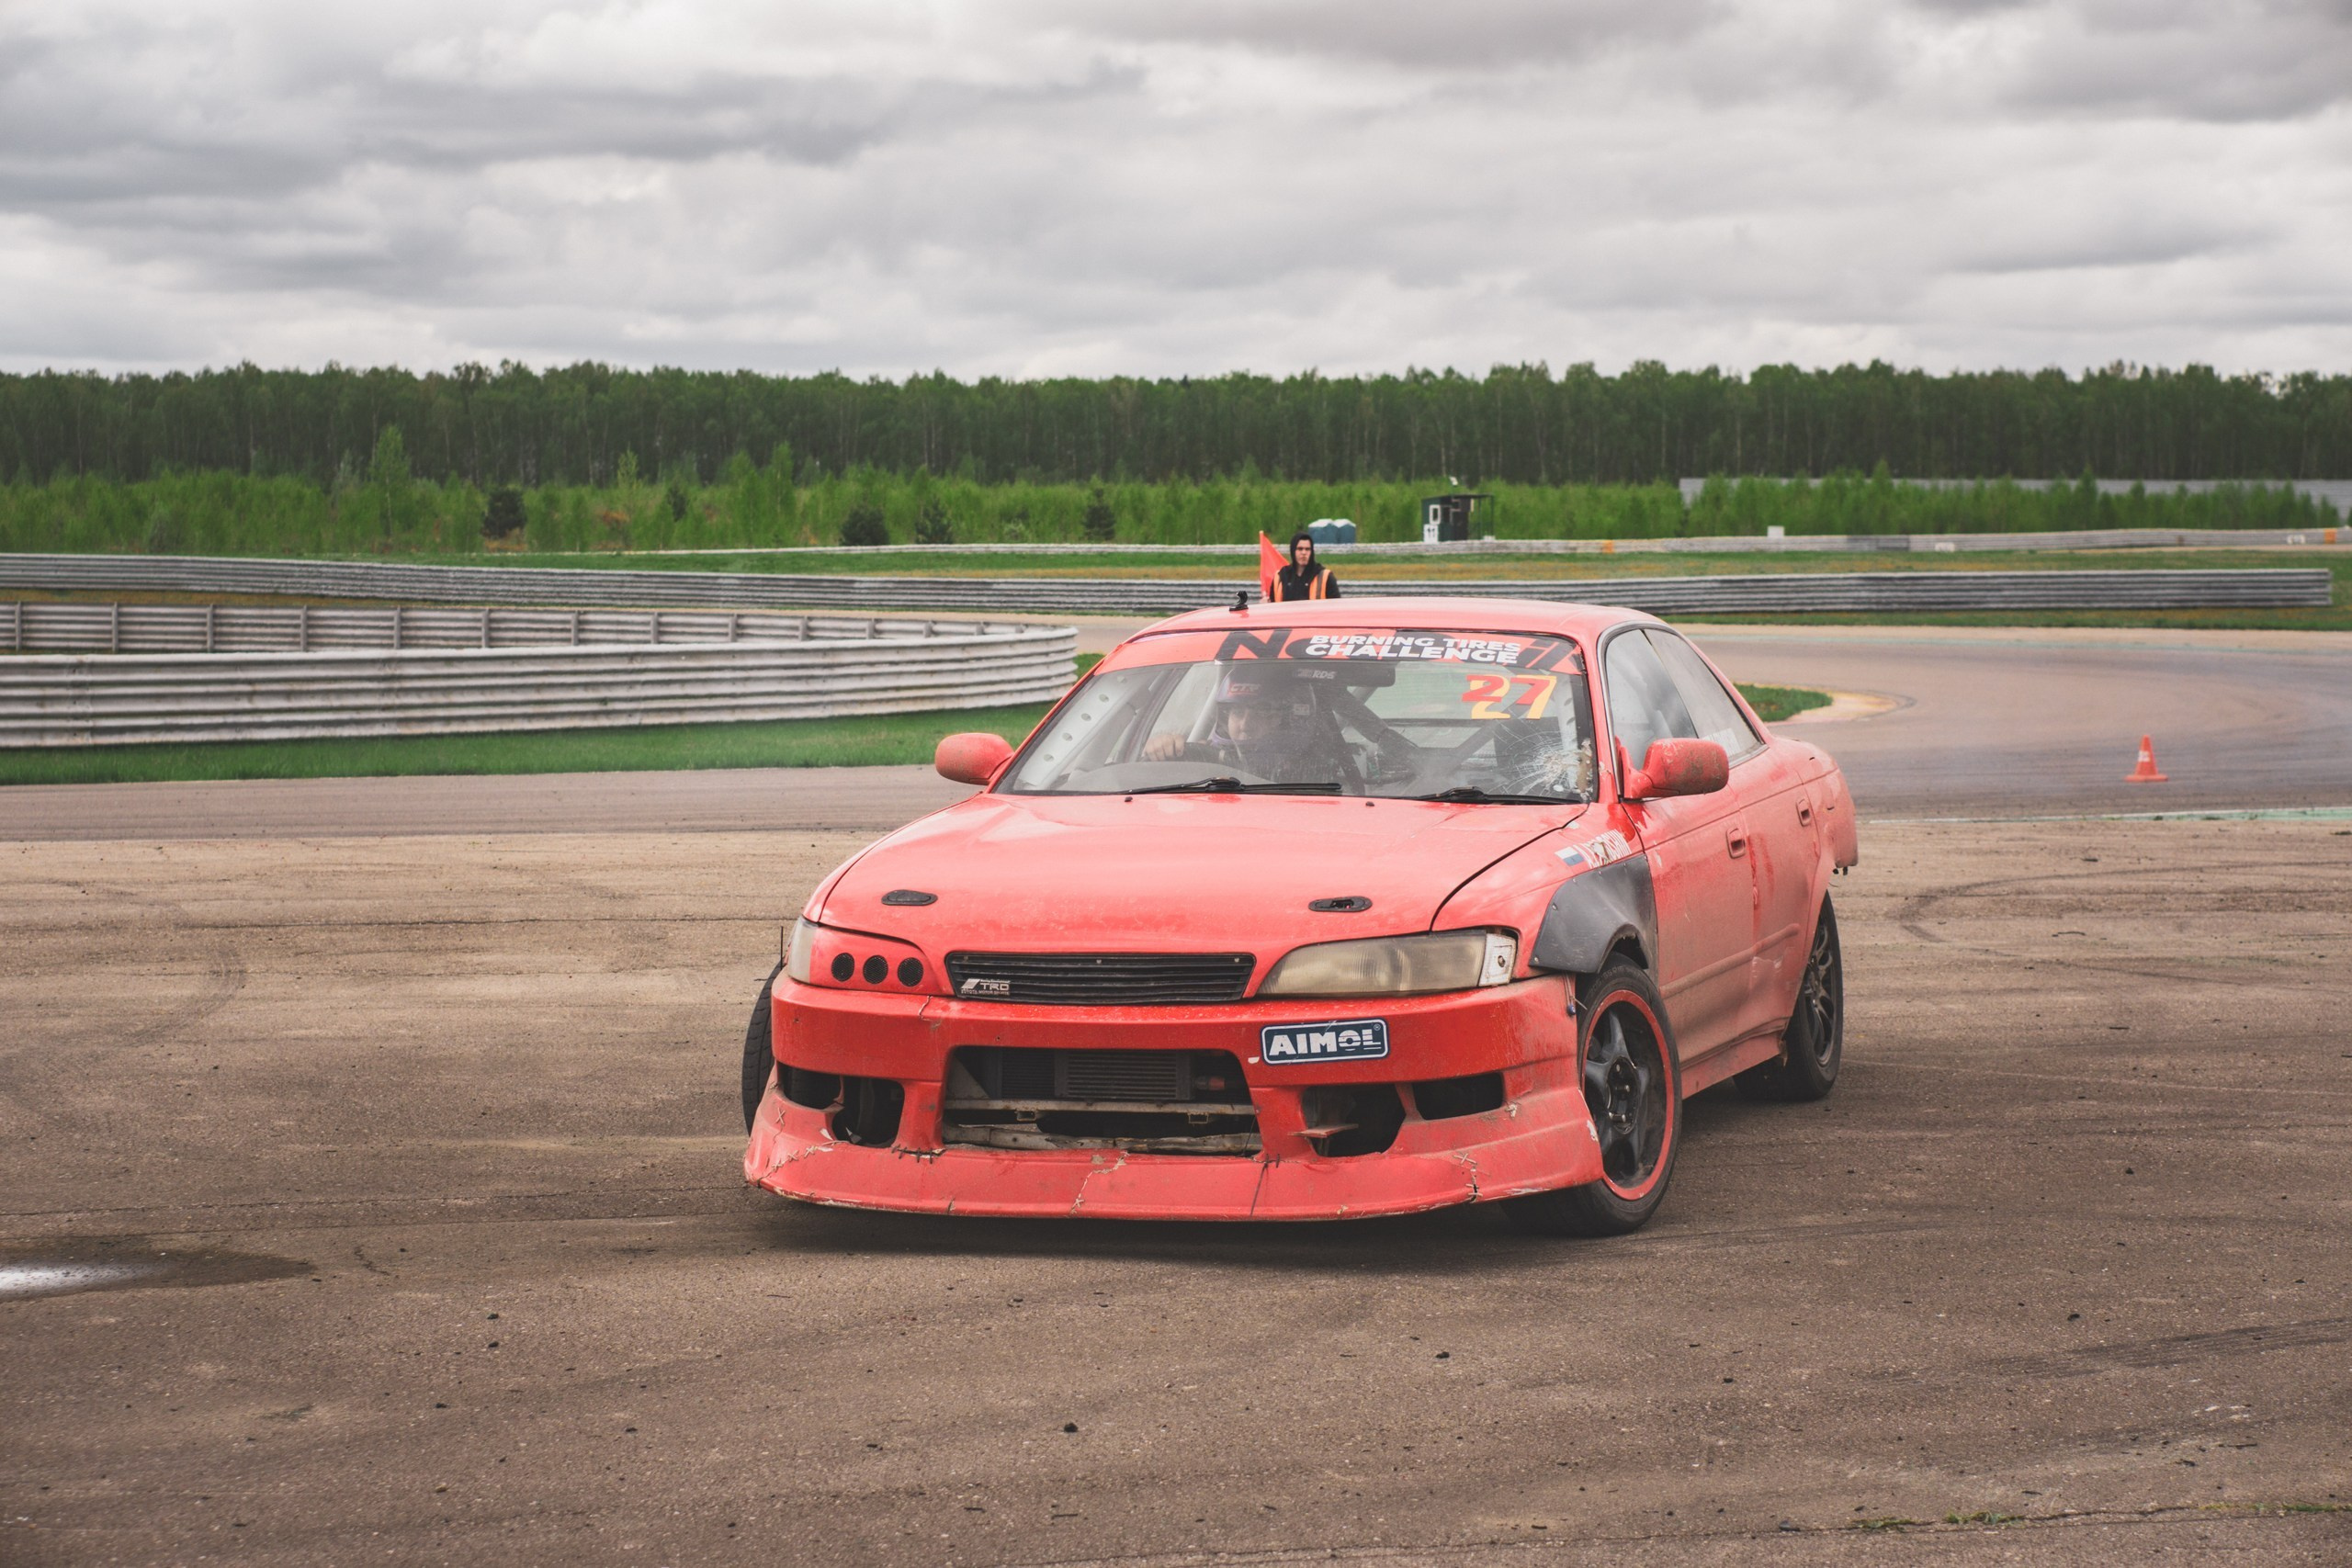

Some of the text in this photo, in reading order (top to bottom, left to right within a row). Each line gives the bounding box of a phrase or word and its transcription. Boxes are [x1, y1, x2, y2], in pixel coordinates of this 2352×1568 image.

[1309, 635, 1521, 652] BURNING TIRES
[1306, 644, 1520, 664] CHALLENGE
[1461, 674, 1557, 720] 27
[979, 983, 1010, 991] TRD
[1269, 1029, 1382, 1056] AIMOL
